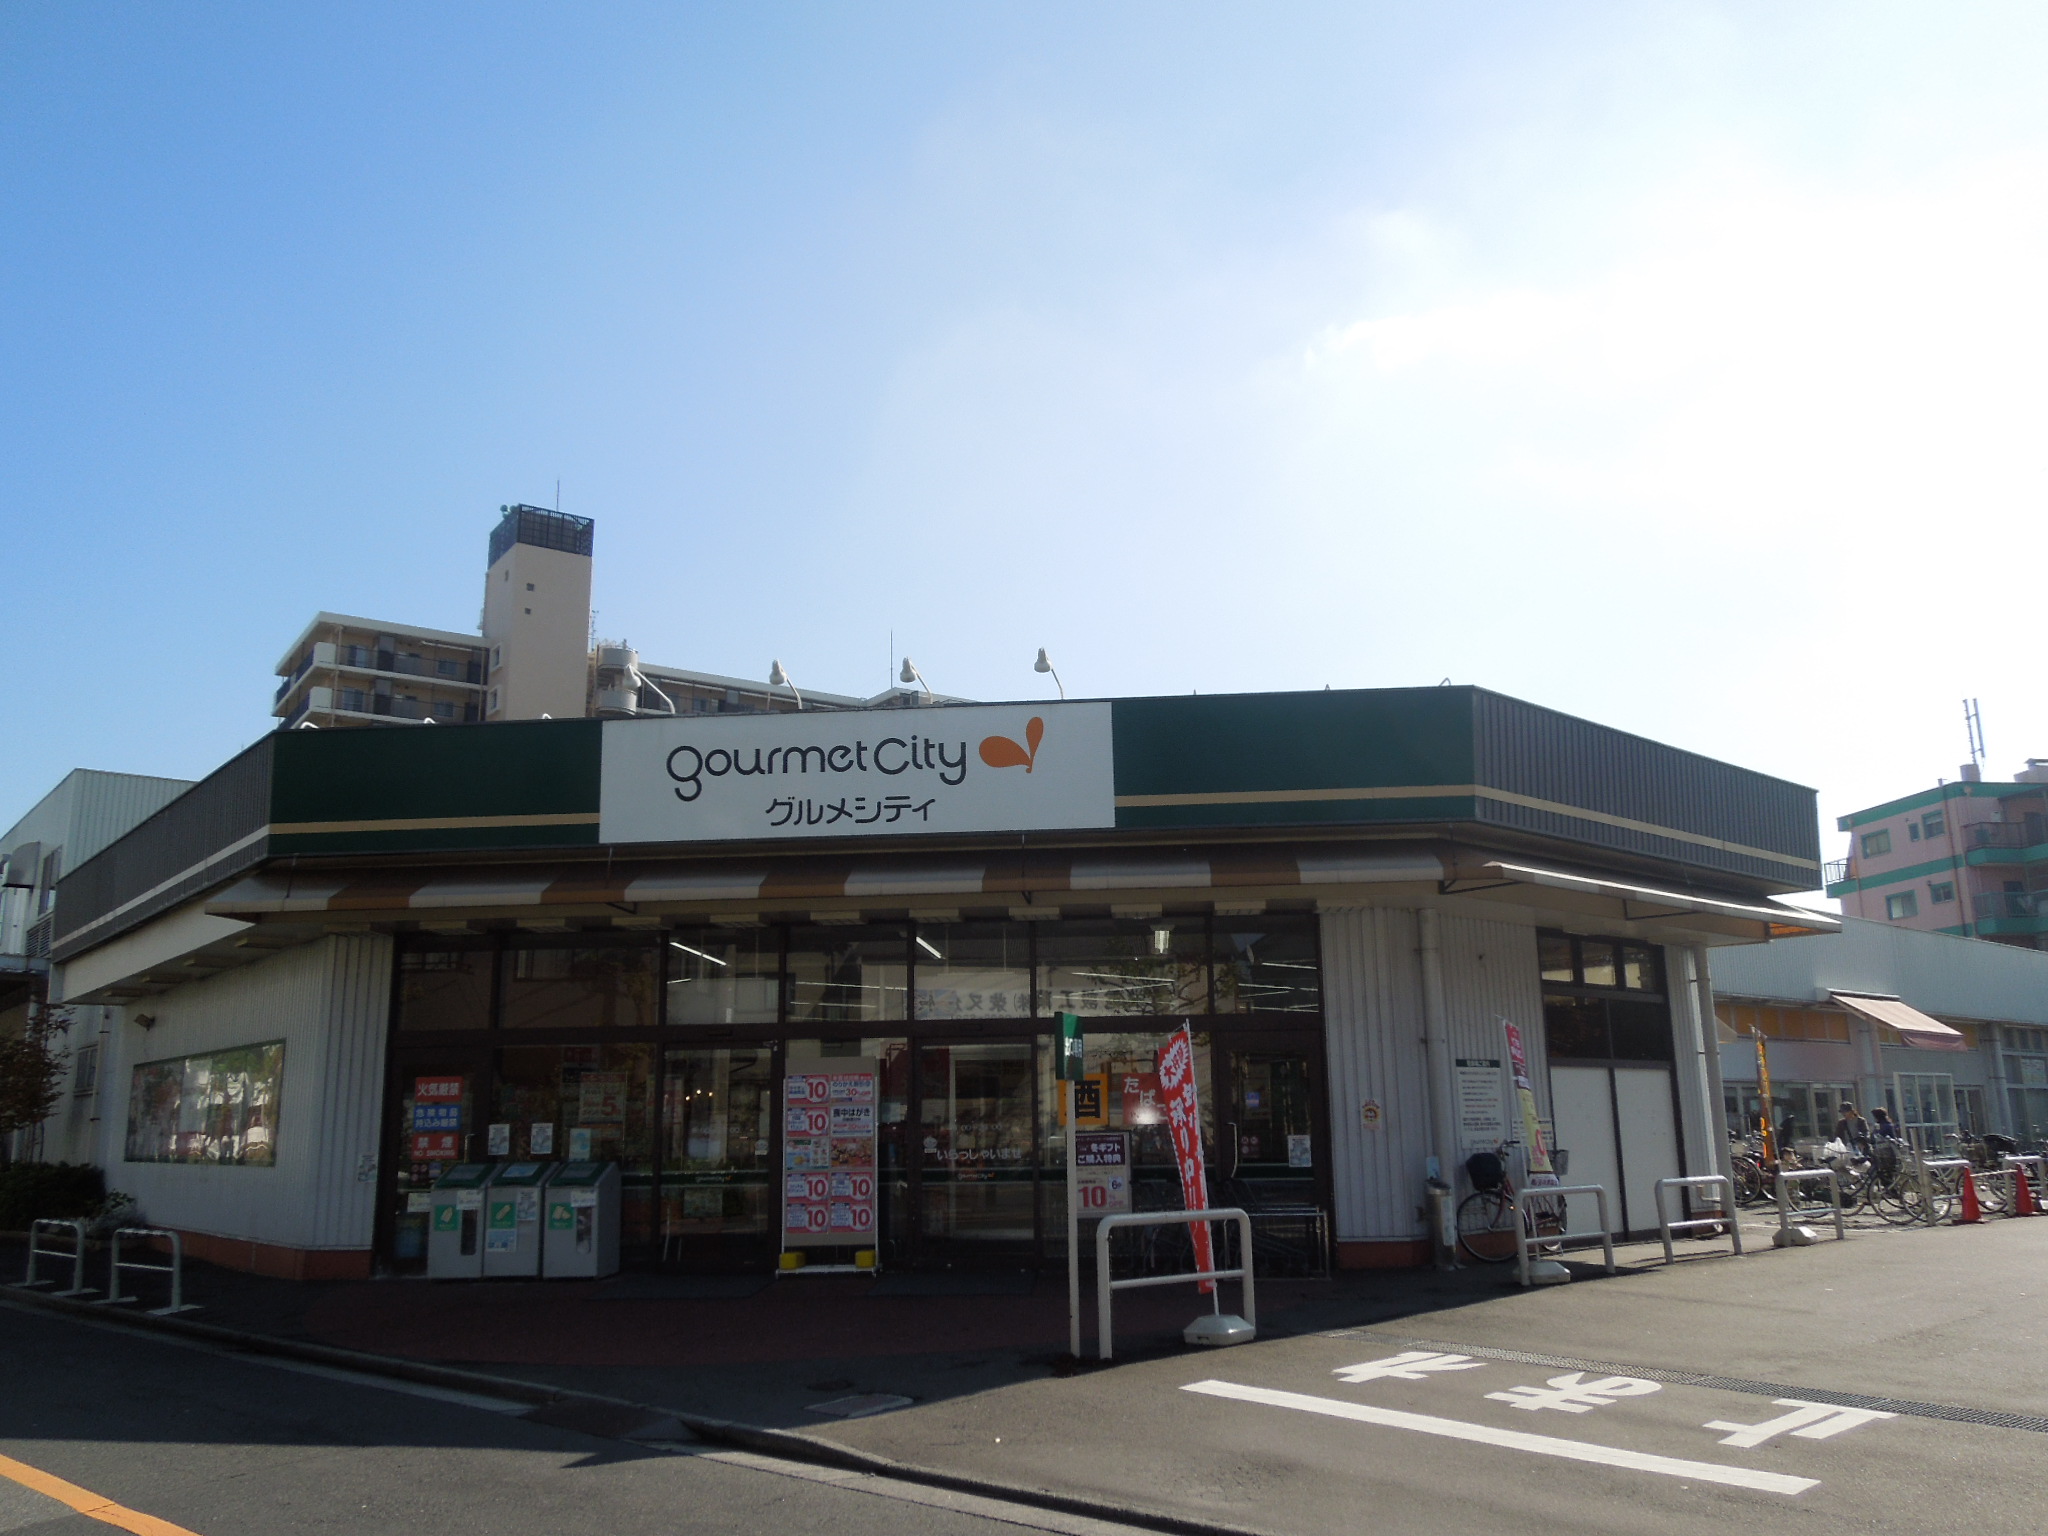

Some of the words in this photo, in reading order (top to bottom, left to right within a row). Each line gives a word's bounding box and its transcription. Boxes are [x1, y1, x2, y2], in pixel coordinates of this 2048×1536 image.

[665, 734, 967, 802] gourmetCity
[764, 794, 936, 827] グルメシティ
[807, 1081, 827, 1099] 10
[806, 1113, 827, 1131] 10
[937, 1148, 1022, 1160] いらっしゃいませ
[1090, 1142, 1121, 1153] 冬ギフト
[1077, 1153, 1122, 1164] ご購入特典
[806, 1179, 827, 1197] 10
[850, 1178, 871, 1196] 10
[1077, 1185, 1107, 1208] 10
[806, 1209, 826, 1227] 10
[850, 1208, 871, 1226] 10
[1331, 1350, 1899, 1449] 止まれ
